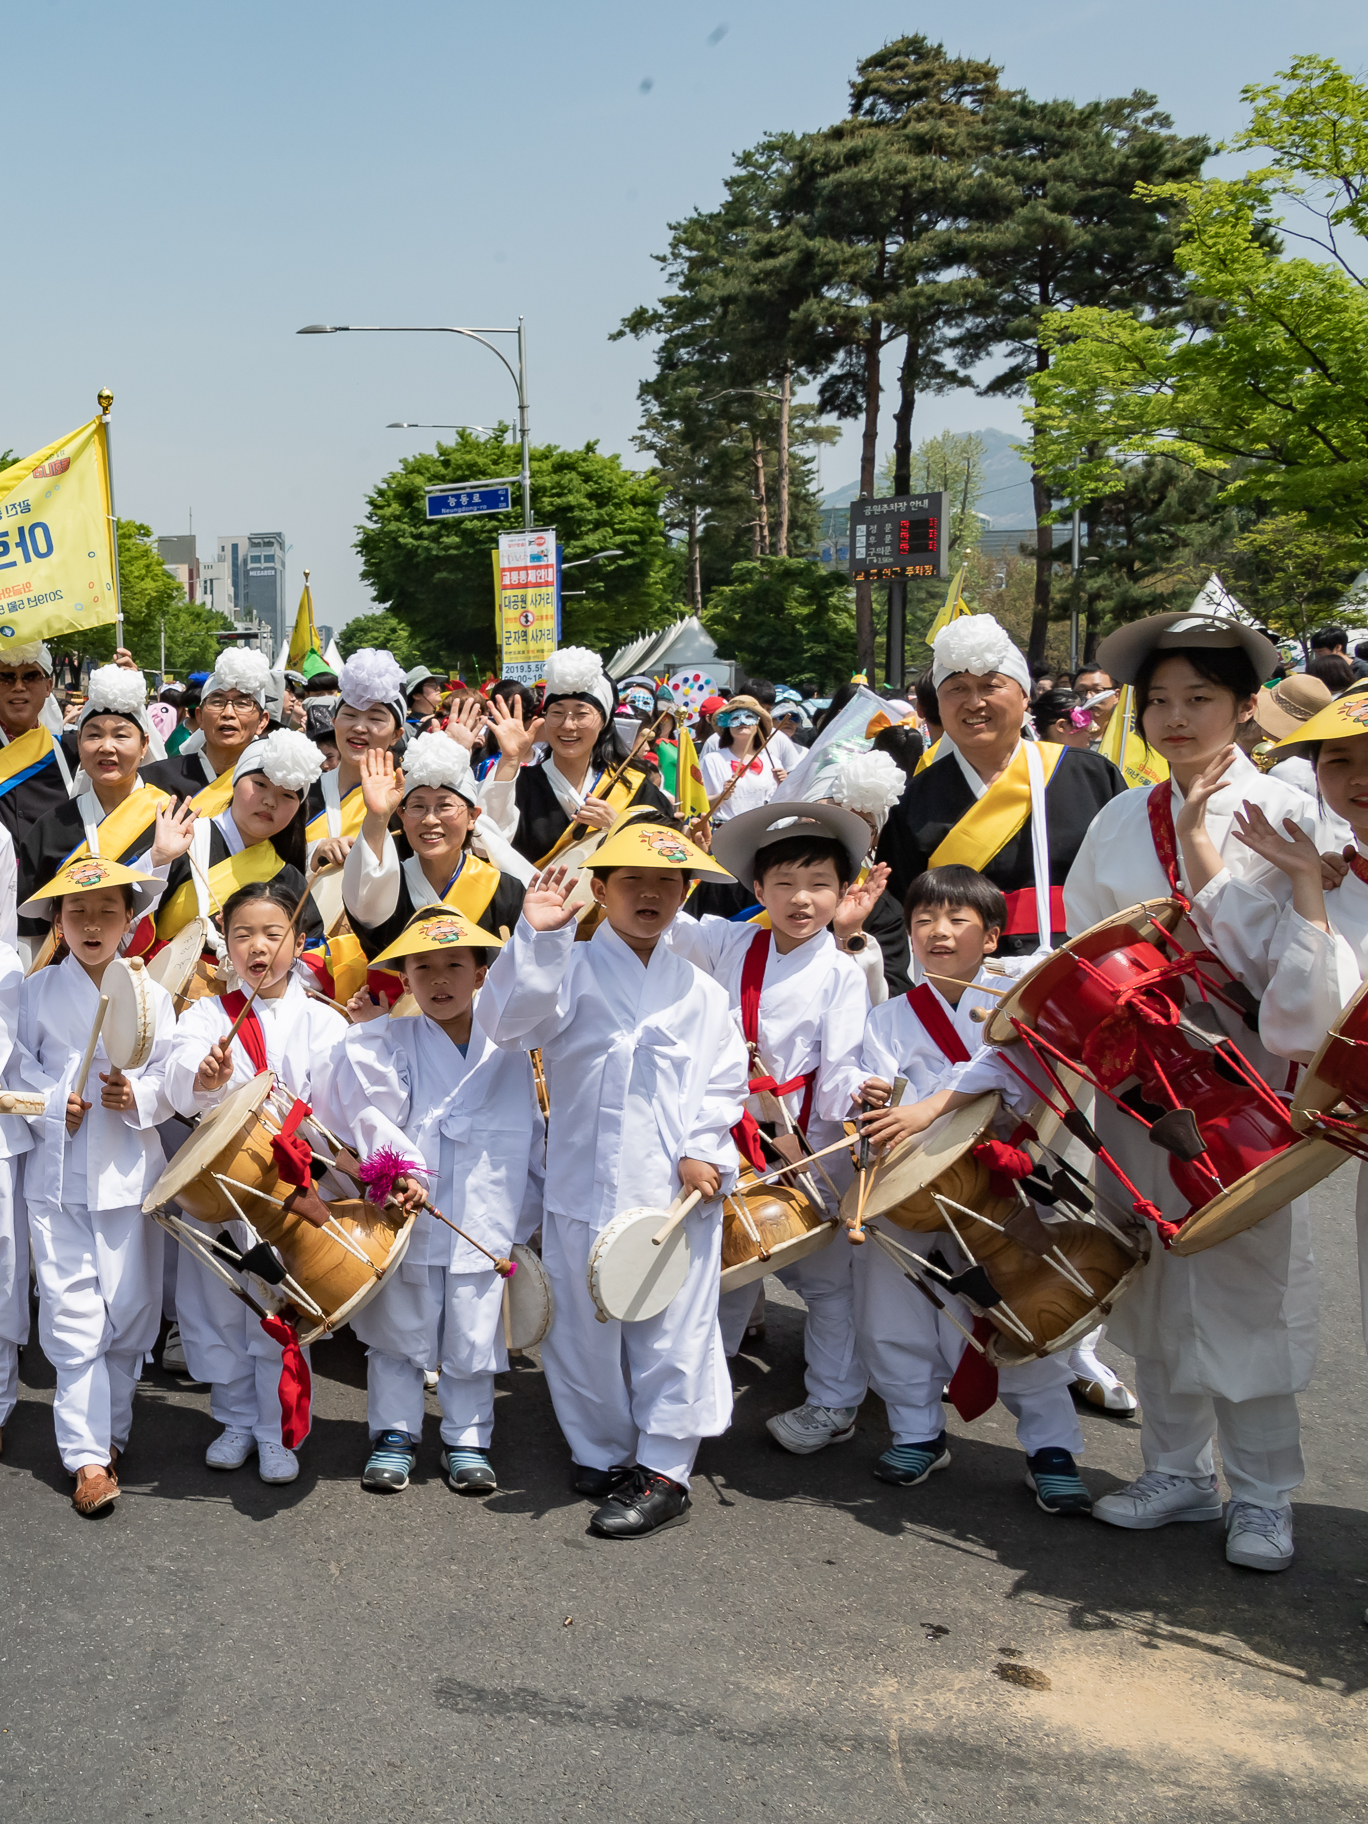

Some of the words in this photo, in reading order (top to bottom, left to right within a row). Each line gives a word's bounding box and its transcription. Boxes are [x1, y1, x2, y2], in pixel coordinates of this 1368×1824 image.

[447, 493, 482, 507] 능동로
[863, 502, 908, 516] 공원주차장
[909, 498, 929, 511] 안내
[441, 504, 488, 514] Neungdong-ro
[867, 546, 893, 556] 구의문
[501, 568, 554, 585] 교통통제안내
[504, 594, 527, 610] 대공원
[530, 592, 554, 608] 사거리
[504, 629, 528, 646] 군자역
[530, 628, 554, 643] 사거리
[1138, 775, 1152, 786] 5월
